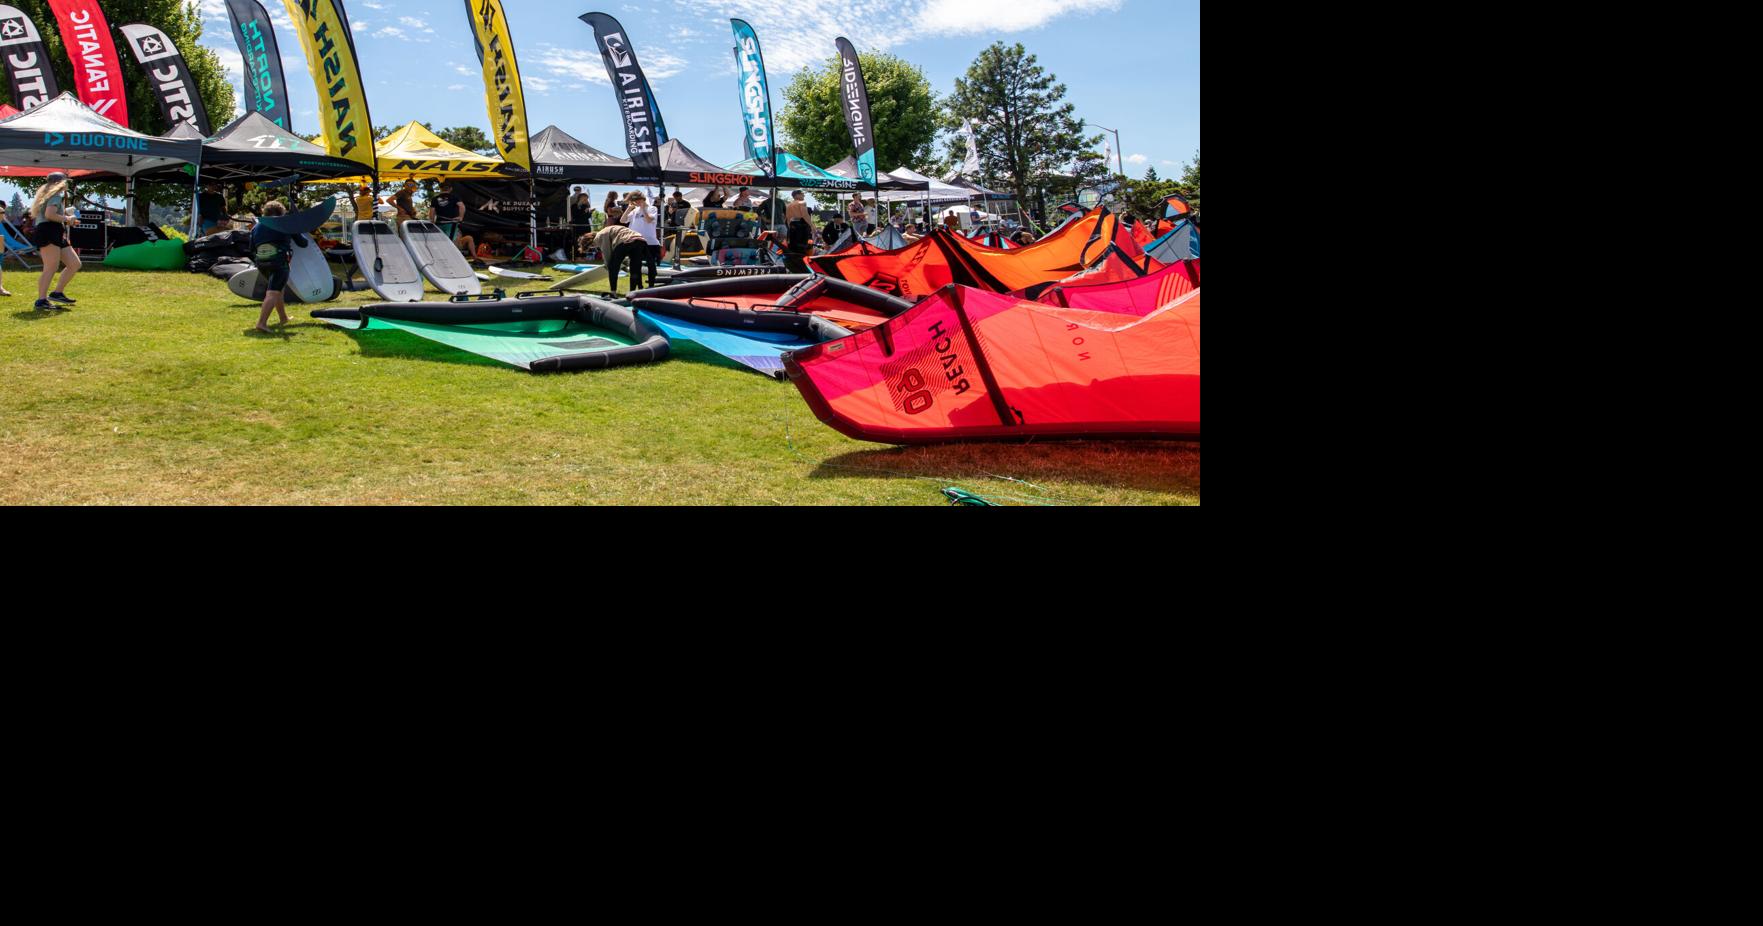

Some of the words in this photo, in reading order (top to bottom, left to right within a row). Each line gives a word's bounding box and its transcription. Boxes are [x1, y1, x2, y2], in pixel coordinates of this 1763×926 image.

[618, 72, 653, 153] AIRUSH
[622, 98, 639, 154] KITEBOARDING
[70, 134, 148, 150] DUOTONE
[536, 165, 564, 173] AIRUSH
[688, 172, 755, 185] SLINGSHOT
